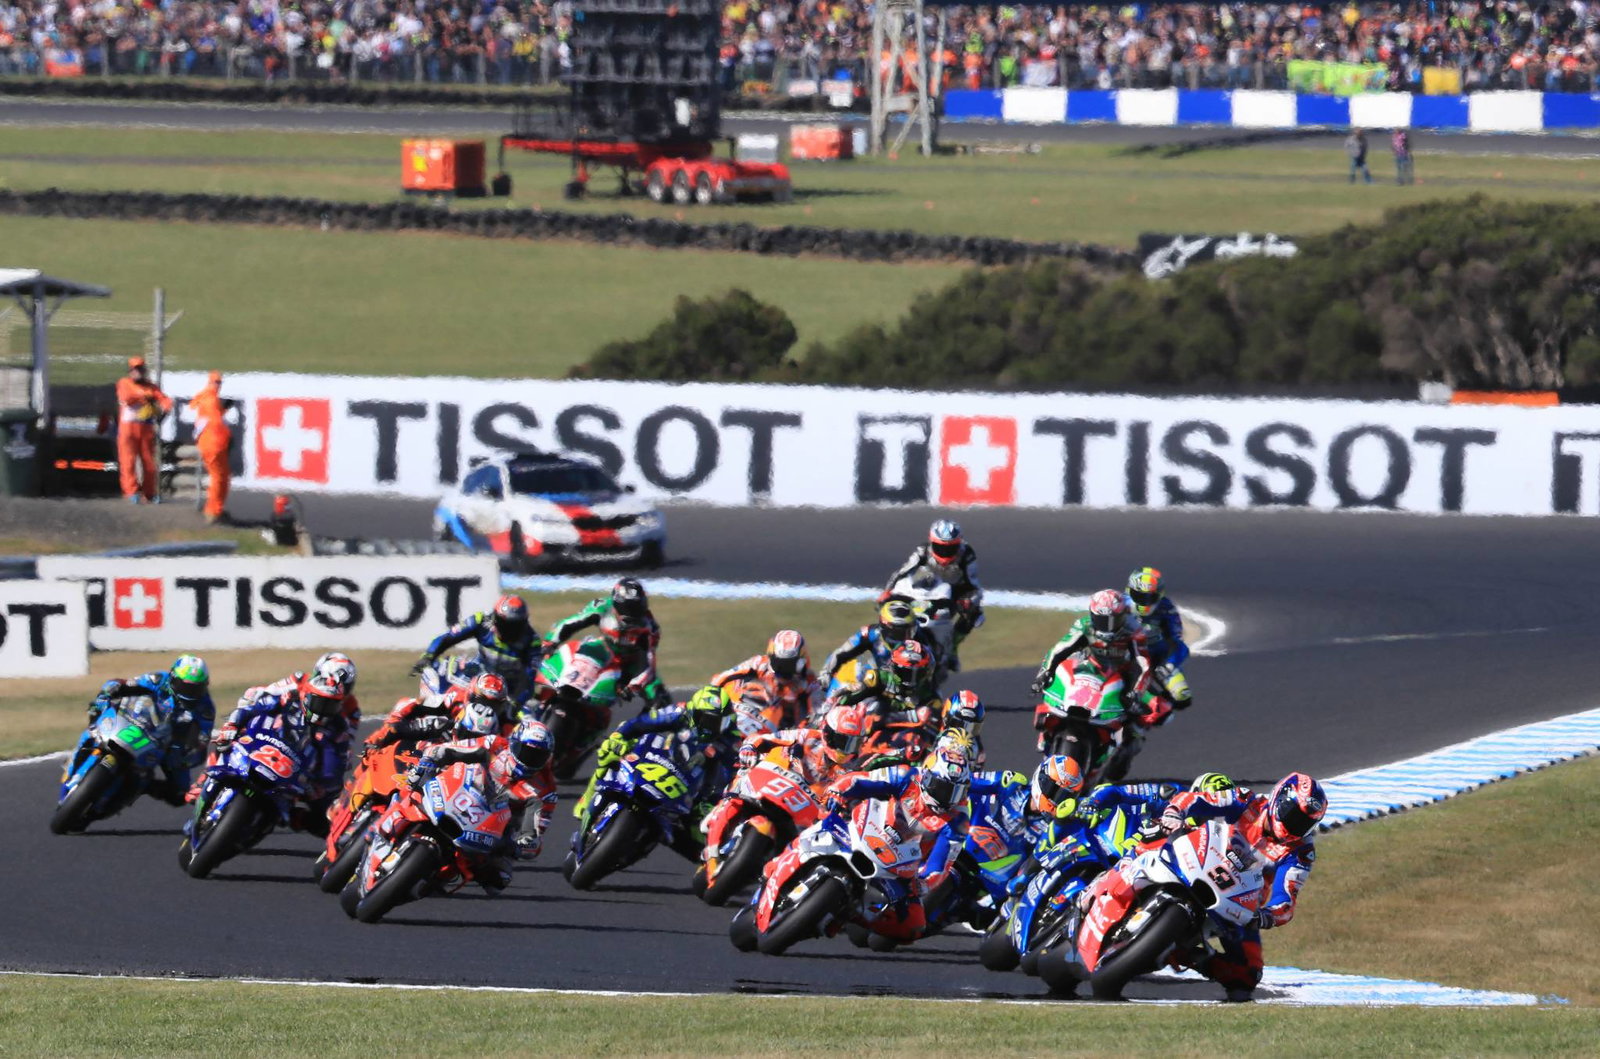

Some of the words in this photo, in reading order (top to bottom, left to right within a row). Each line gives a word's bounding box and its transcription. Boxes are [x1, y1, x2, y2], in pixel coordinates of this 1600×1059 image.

[348, 401, 801, 494] TISSOT
[1032, 416, 1496, 513] TISSOT
[176, 576, 481, 628] TISSOT
[116, 725, 150, 750] 21
[249, 745, 293, 778] 25
[635, 763, 688, 799] 46
[761, 778, 811, 812] 93
